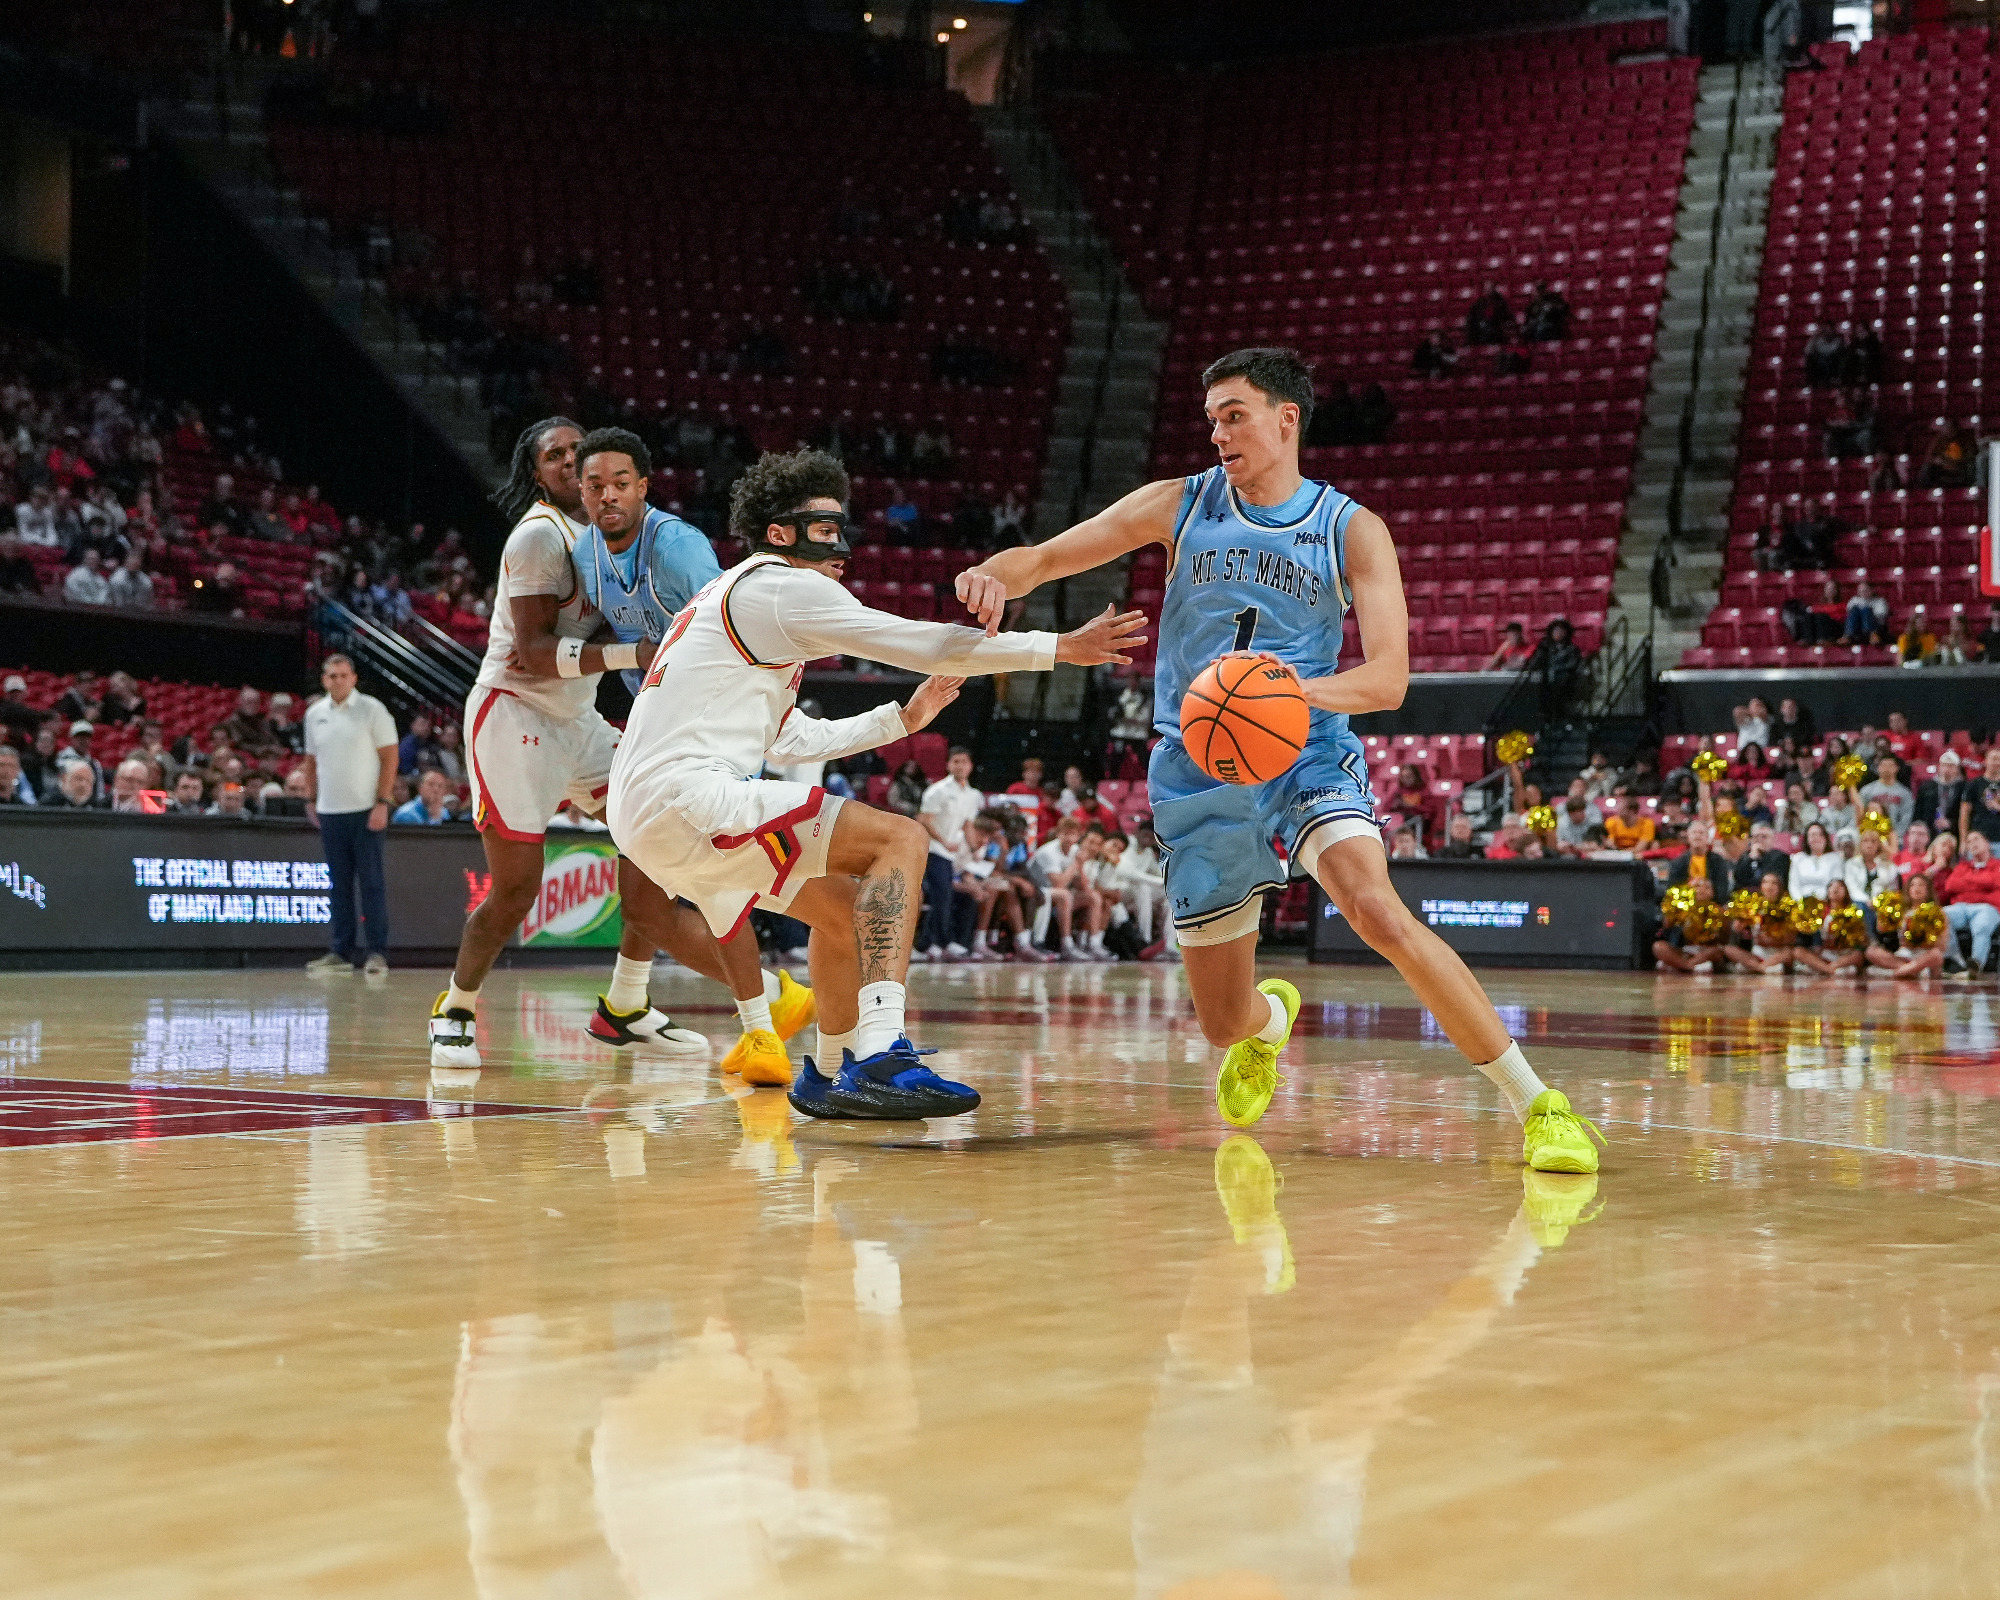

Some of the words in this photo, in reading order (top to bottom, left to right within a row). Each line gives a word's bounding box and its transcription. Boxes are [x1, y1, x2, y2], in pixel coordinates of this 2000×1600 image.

[1192, 549, 1218, 586] MT.
[1223, 548, 1250, 582] ST.
[1253, 550, 1320, 607] MARY'S
[1233, 605, 1260, 651] 1
[132, 857, 164, 887] THE
[166, 858, 231, 888] OFFICIAL
[232, 860, 291, 889] ORANGE
[292, 861, 333, 890] CRUS
[149, 894, 170, 922] OF
[171, 894, 253, 923] MARYLAND
[255, 895, 331, 923] ATHLETICS
